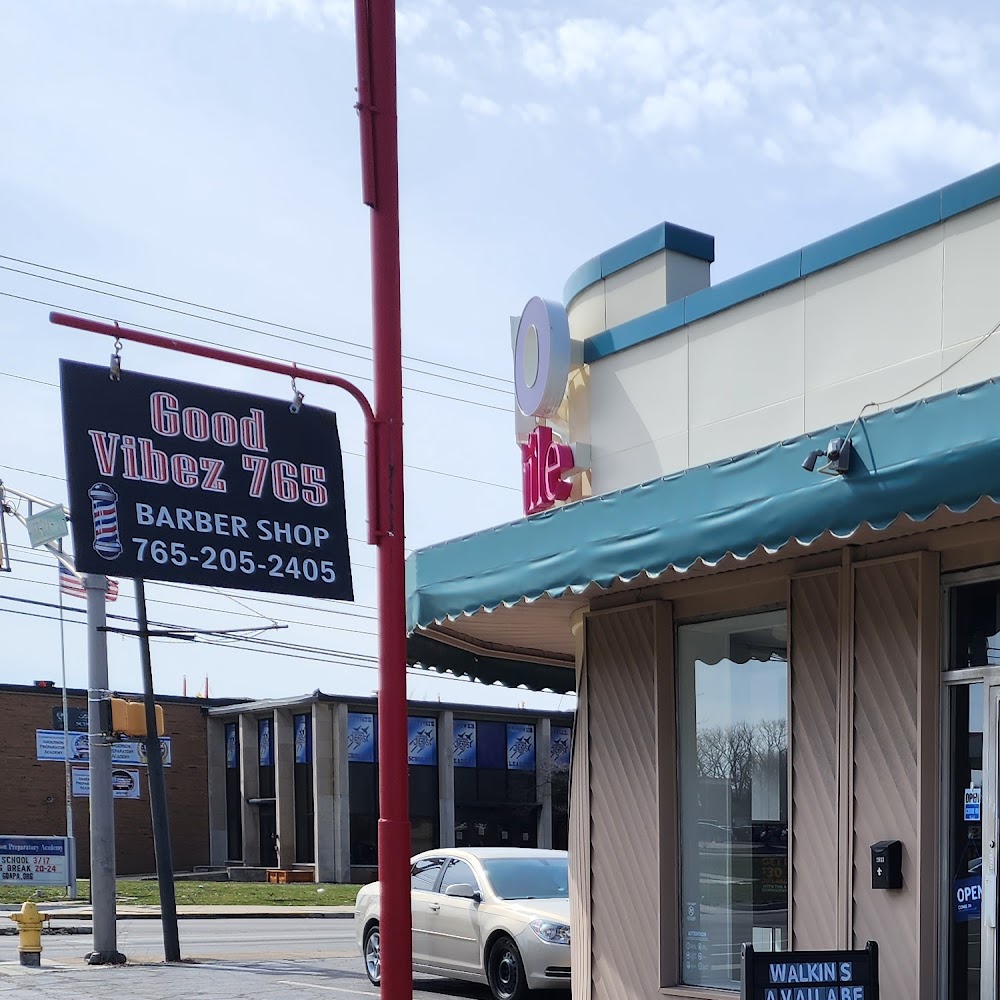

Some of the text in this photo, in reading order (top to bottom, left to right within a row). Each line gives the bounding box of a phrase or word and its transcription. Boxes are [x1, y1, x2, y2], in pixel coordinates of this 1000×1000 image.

[150, 391, 268, 452] Good
[88, 429, 329, 507] Vibez 765
[135, 503, 330, 547] BARBER SHOP
[132, 537, 336, 583] 765-205-2405
[2, 856, 29, 864] SCHOOL
[34, 865, 57, 873] 20-24
